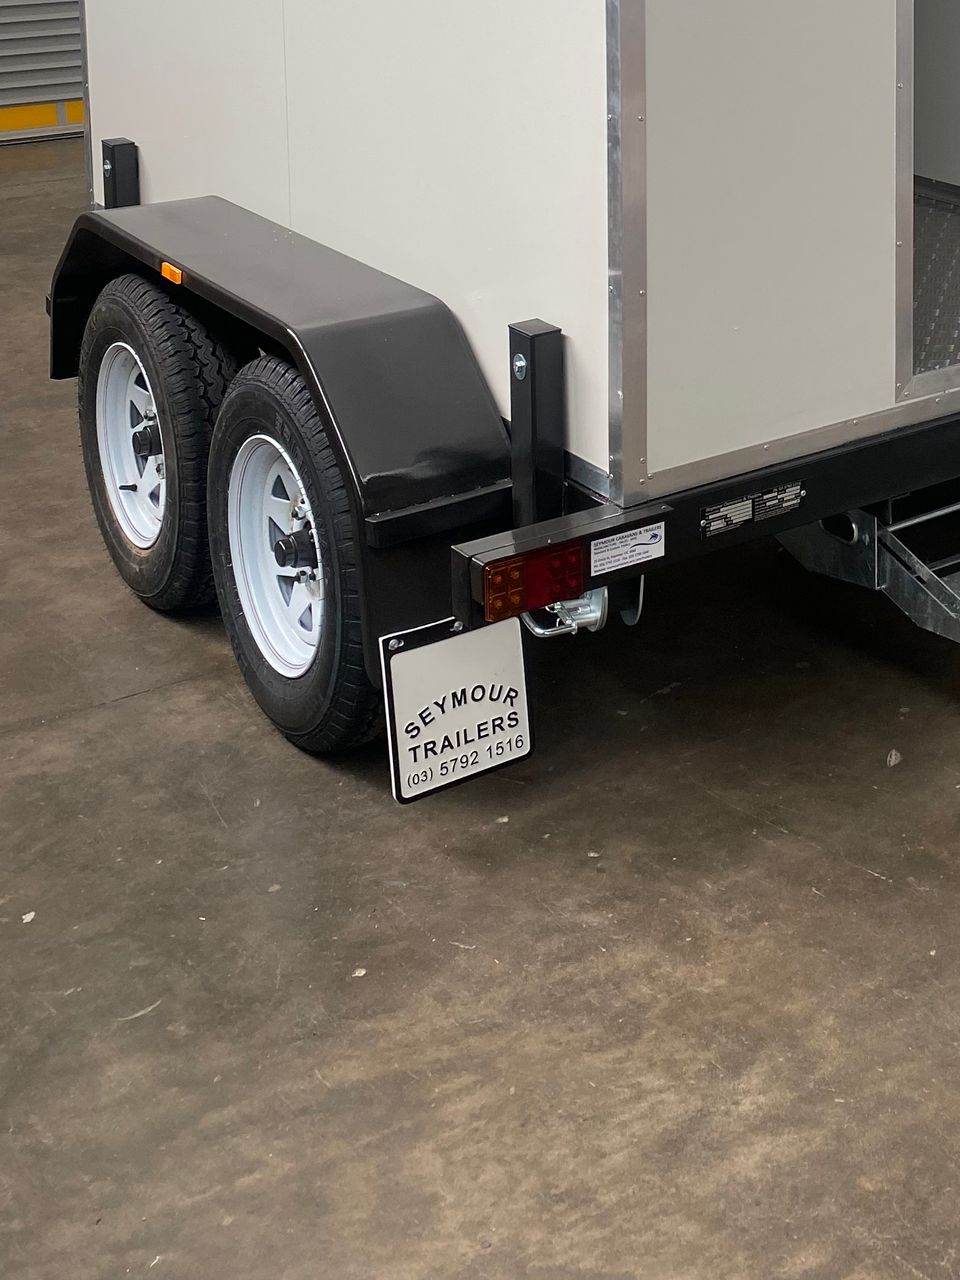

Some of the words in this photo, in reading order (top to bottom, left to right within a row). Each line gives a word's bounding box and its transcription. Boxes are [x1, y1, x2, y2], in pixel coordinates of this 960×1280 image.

[404, 684, 519, 739] SEYMOUR
[408, 711, 519, 763] TRAILERS
[407, 768, 434, 788] (03)
[440, 751, 479, 776] 5792
[486, 735, 524, 759] 1516
